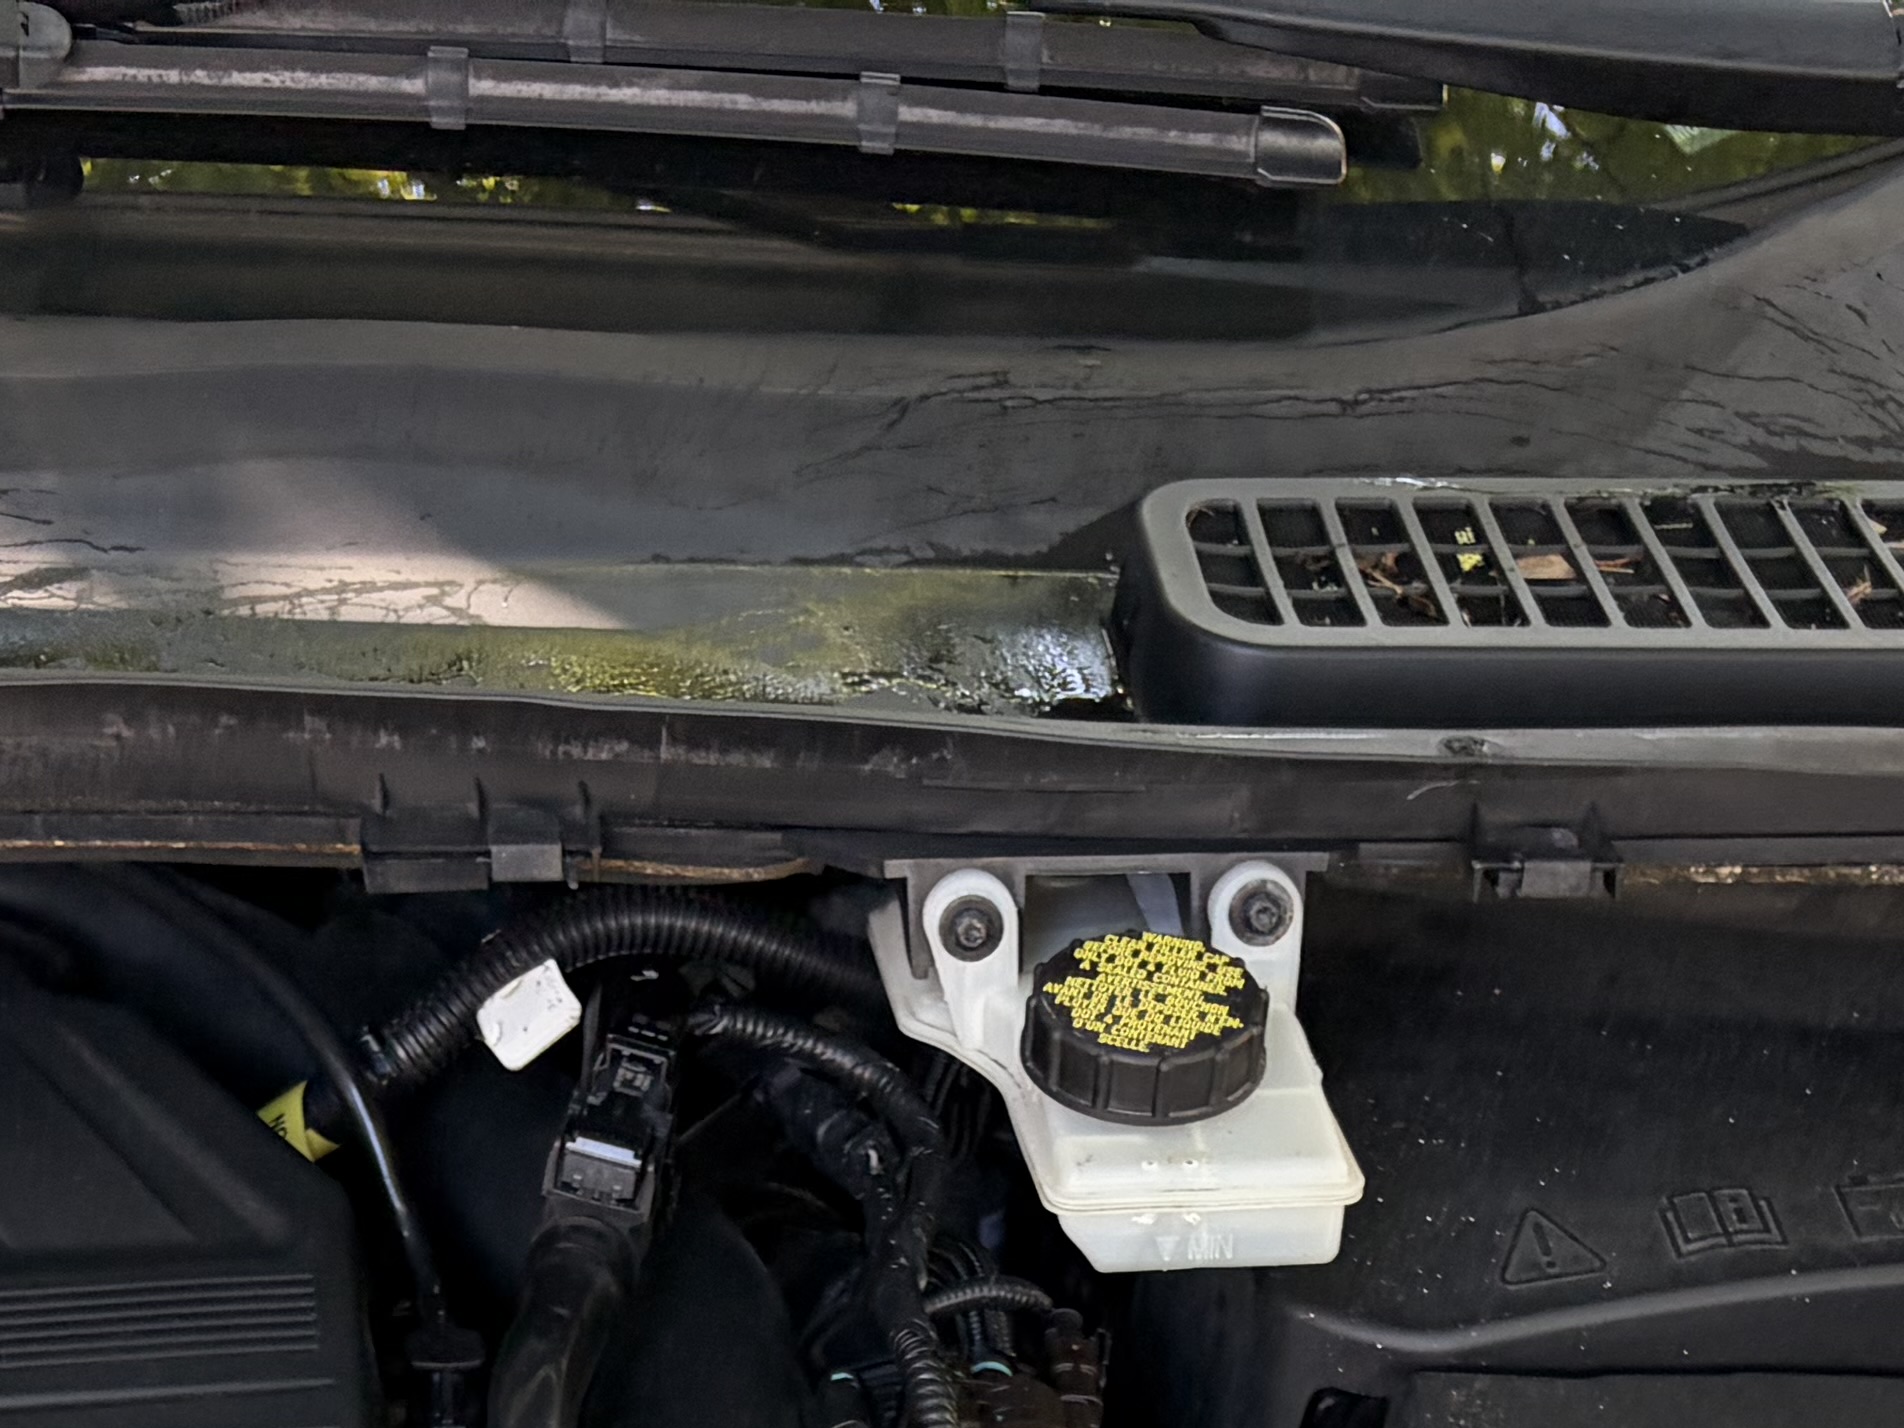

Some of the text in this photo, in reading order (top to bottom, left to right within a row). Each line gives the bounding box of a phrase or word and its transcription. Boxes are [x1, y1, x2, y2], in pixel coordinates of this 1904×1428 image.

[1104, 934, 1230, 965] CLEAN FILLER CAP
[1074, 949, 1107, 963] ONLY
[1116, 956, 1138, 967] DOT
[1162, 964, 1199, 979] FLUID
[1206, 973, 1244, 988] FROM
[1097, 963, 1146, 979] SEALED
[1217, 965, 1242, 977] USE
[1187, 1232, 1233, 1260] MIN
